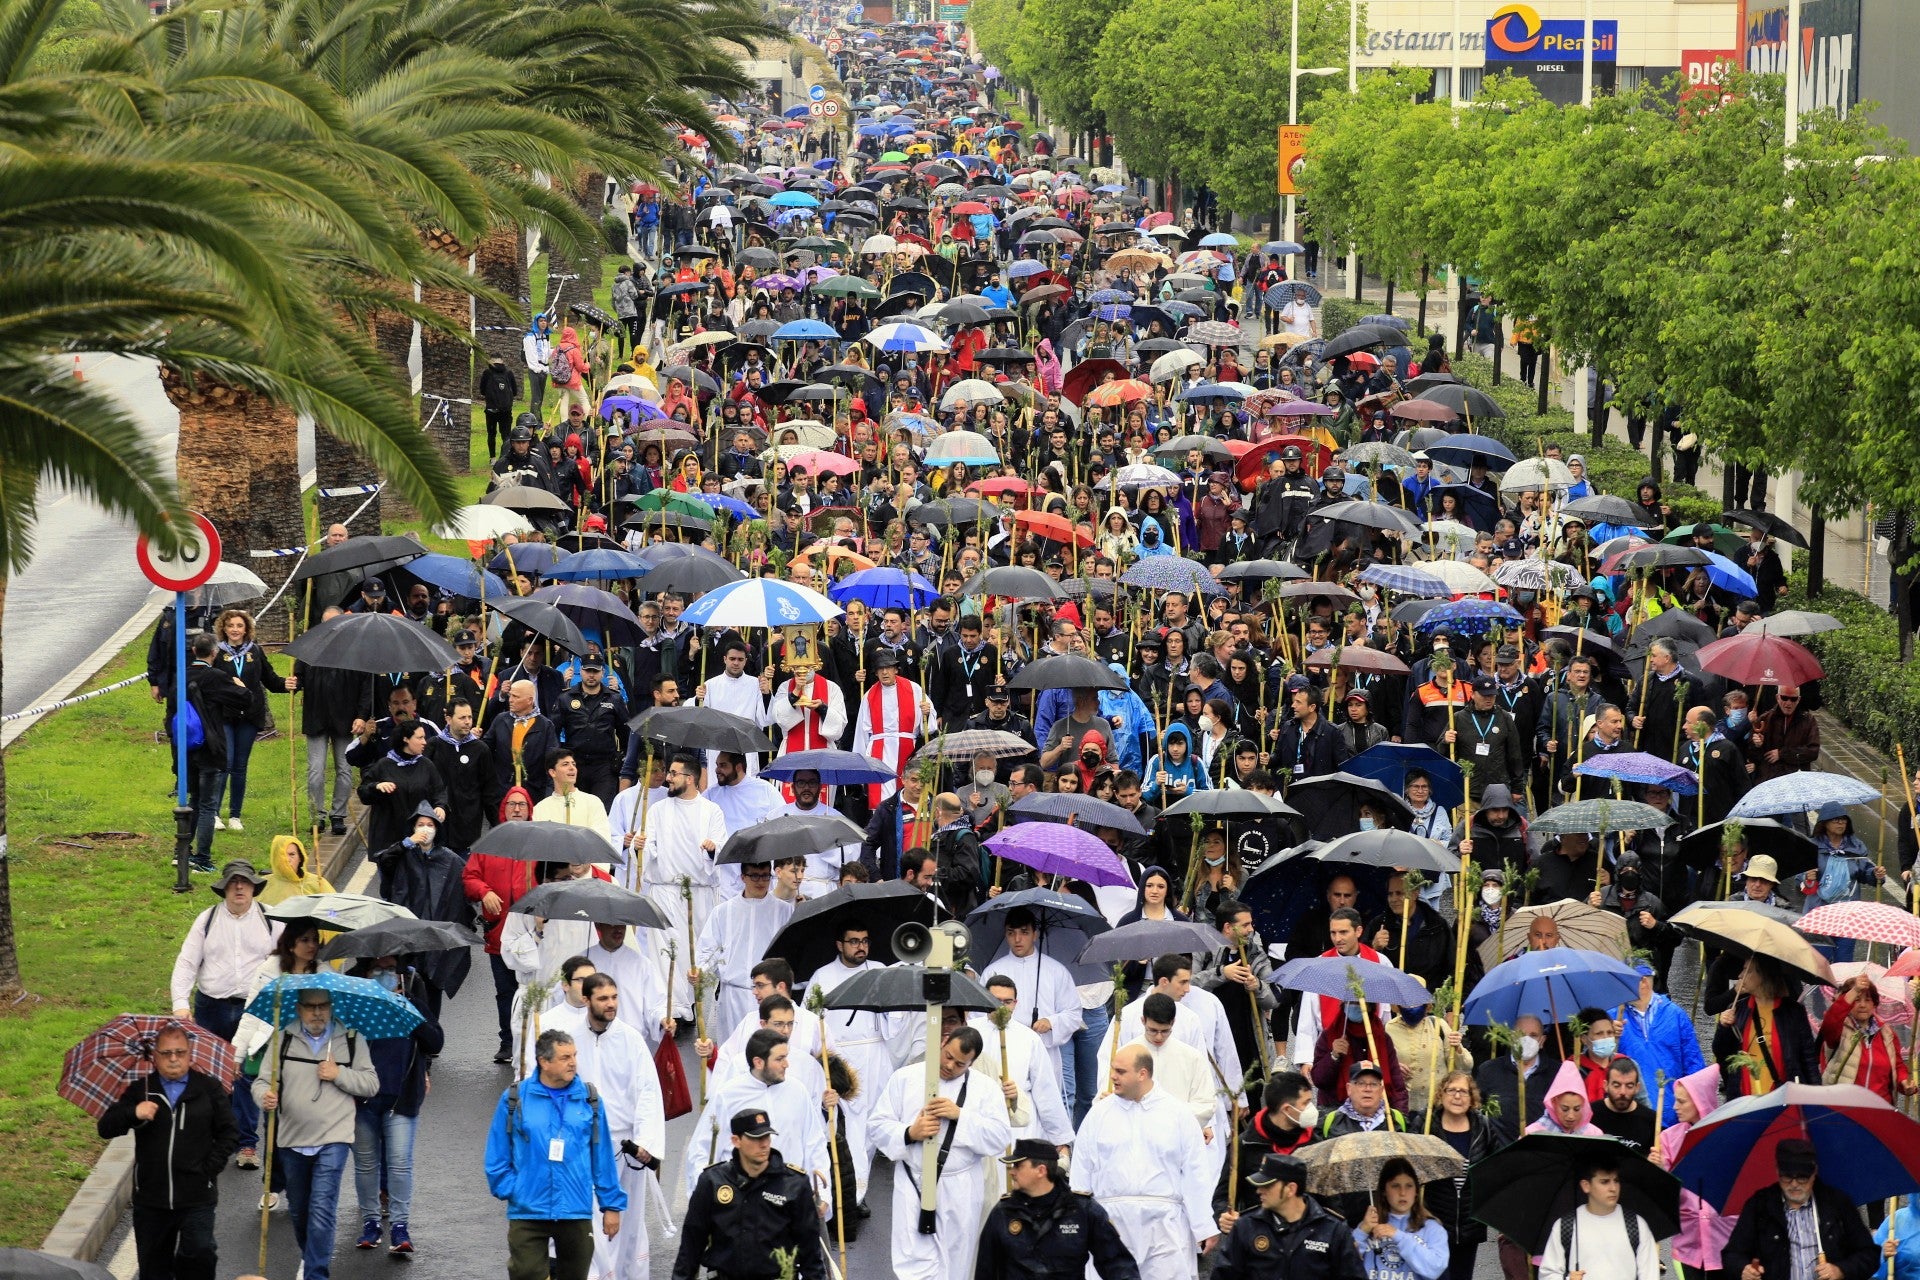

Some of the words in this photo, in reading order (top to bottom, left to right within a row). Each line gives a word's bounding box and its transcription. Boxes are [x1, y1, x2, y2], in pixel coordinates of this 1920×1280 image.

[1543, 33, 1614, 51] Plenoil
[1536, 64, 1566, 72] DIESEL
[1369, 1269, 1415, 1280] ROMA
